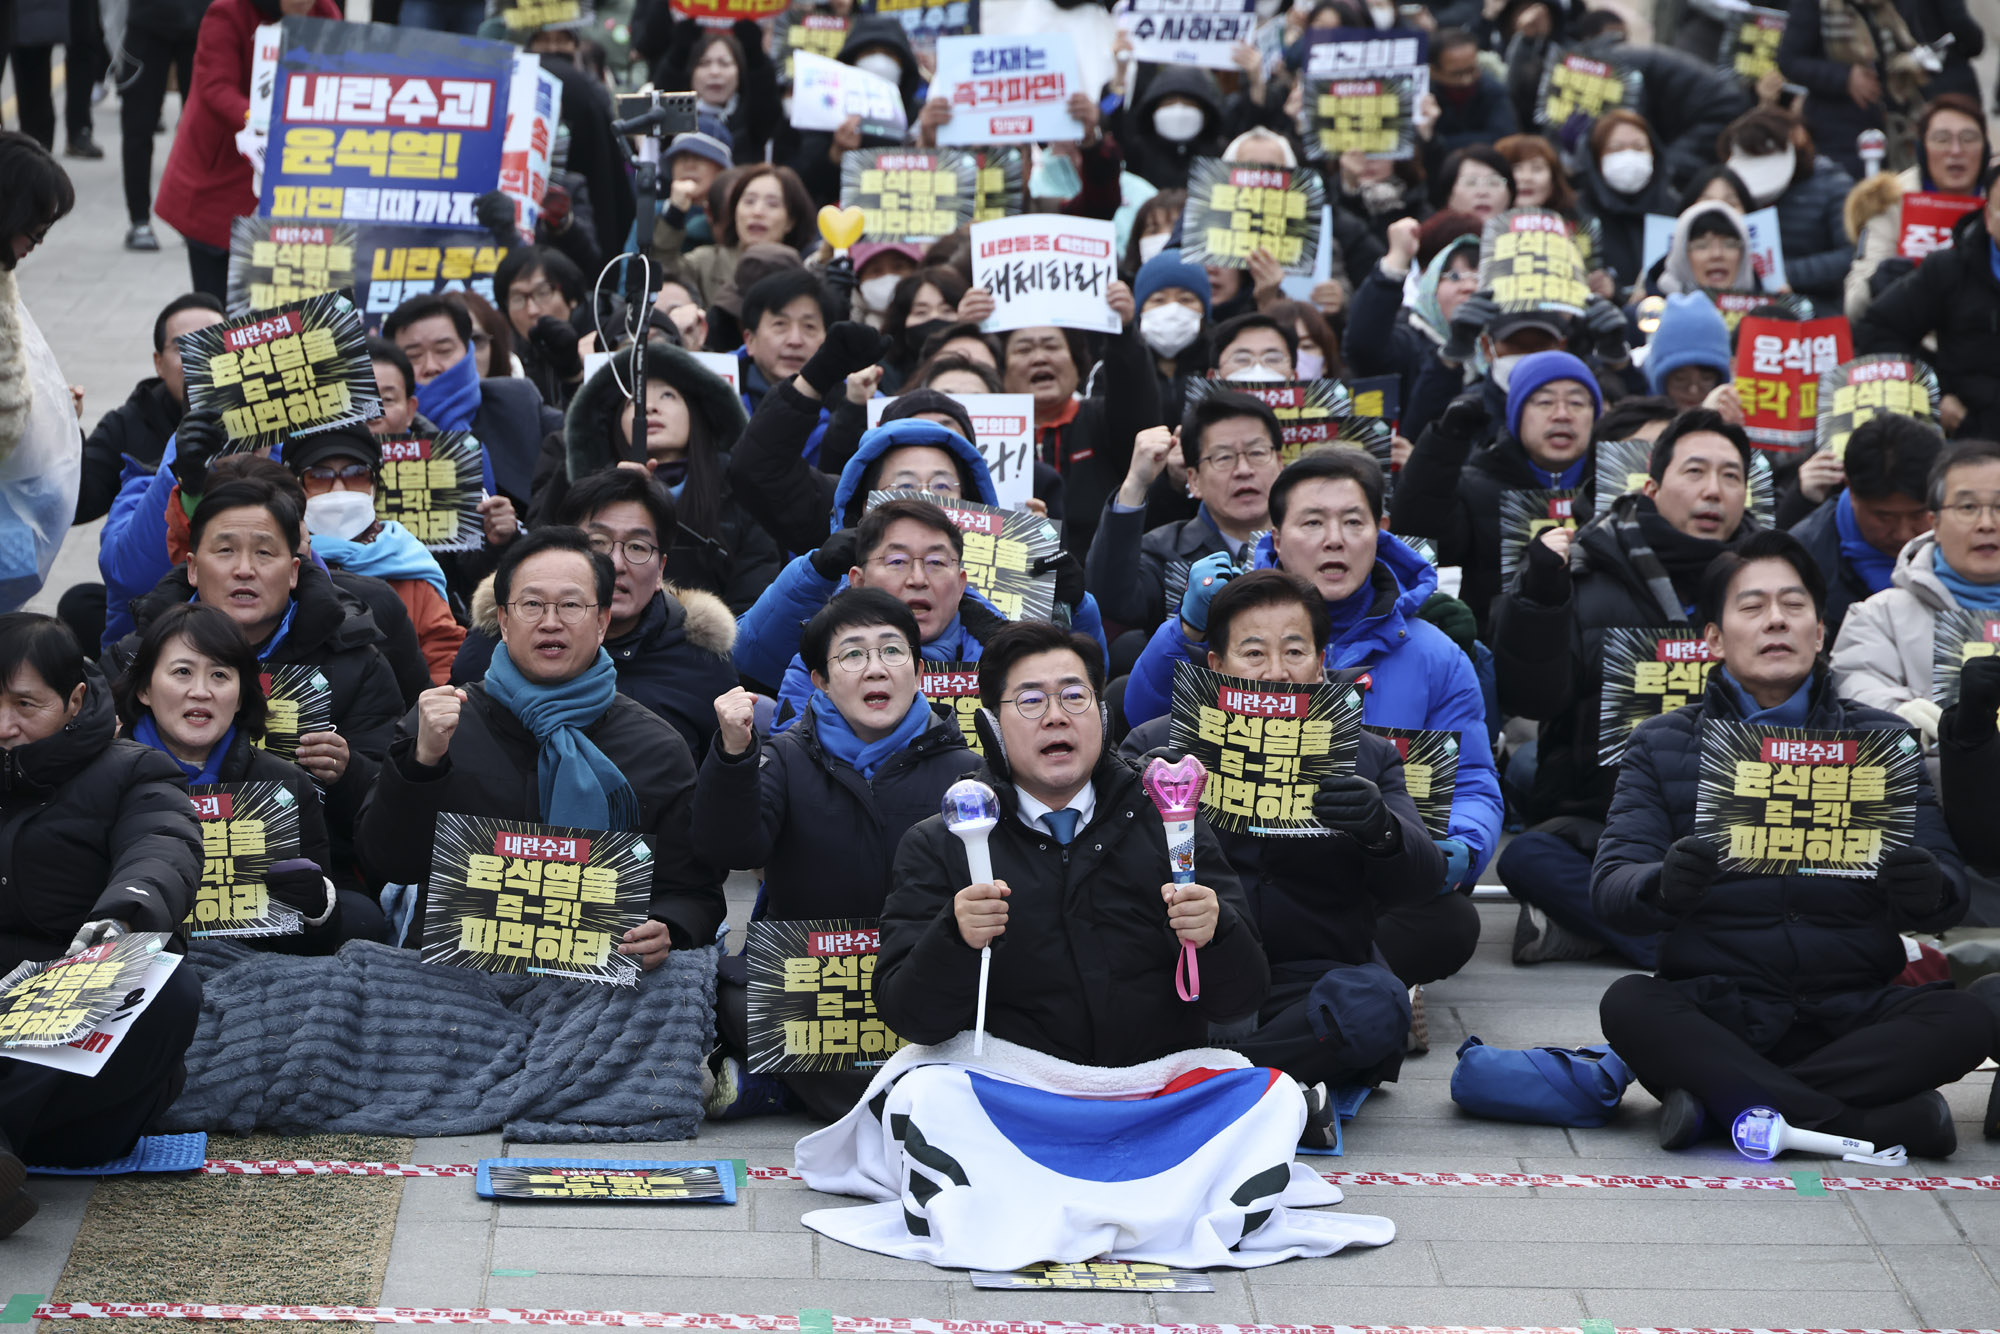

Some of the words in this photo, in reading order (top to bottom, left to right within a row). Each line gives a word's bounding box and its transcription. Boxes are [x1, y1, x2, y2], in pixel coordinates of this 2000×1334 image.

[972, 46, 1046, 76] 헌재는
[285, 75, 492, 128] 내란수괴
[281, 127, 462, 180] 윤석열!
[230, 315, 292, 346] 내란수괴
[210, 326, 338, 389] 윤석열을
[1753, 334, 1838, 376] 윤석열
[975, 417, 1022, 435] 민의힘
[944, 509, 991, 533] 란수괴
[1665, 641, 1711, 660] 내란수
[1226, 691, 1297, 715] 내란수괴
[1199, 705, 1333, 756] 윤석열을
[1220, 748, 1301, 784] 즉-각!
[1771, 741, 1844, 763] 내란수괴
[1734, 760, 1886, 801] 윤석열을
[1764, 800, 1852, 829] 즉-각!
[504, 836, 576, 859] 내란수괴
[1728, 825, 1882, 863] 파면하라
[466, 853, 619, 905] 윤석열을
[495, 893, 582, 928] 즉-각!
[458, 916, 612, 967] 파면하라
[784, 955, 878, 992] 윤석
[784, 1017, 912, 1056] 파면하
[520, 1312, 624, 1323] DANGER!
